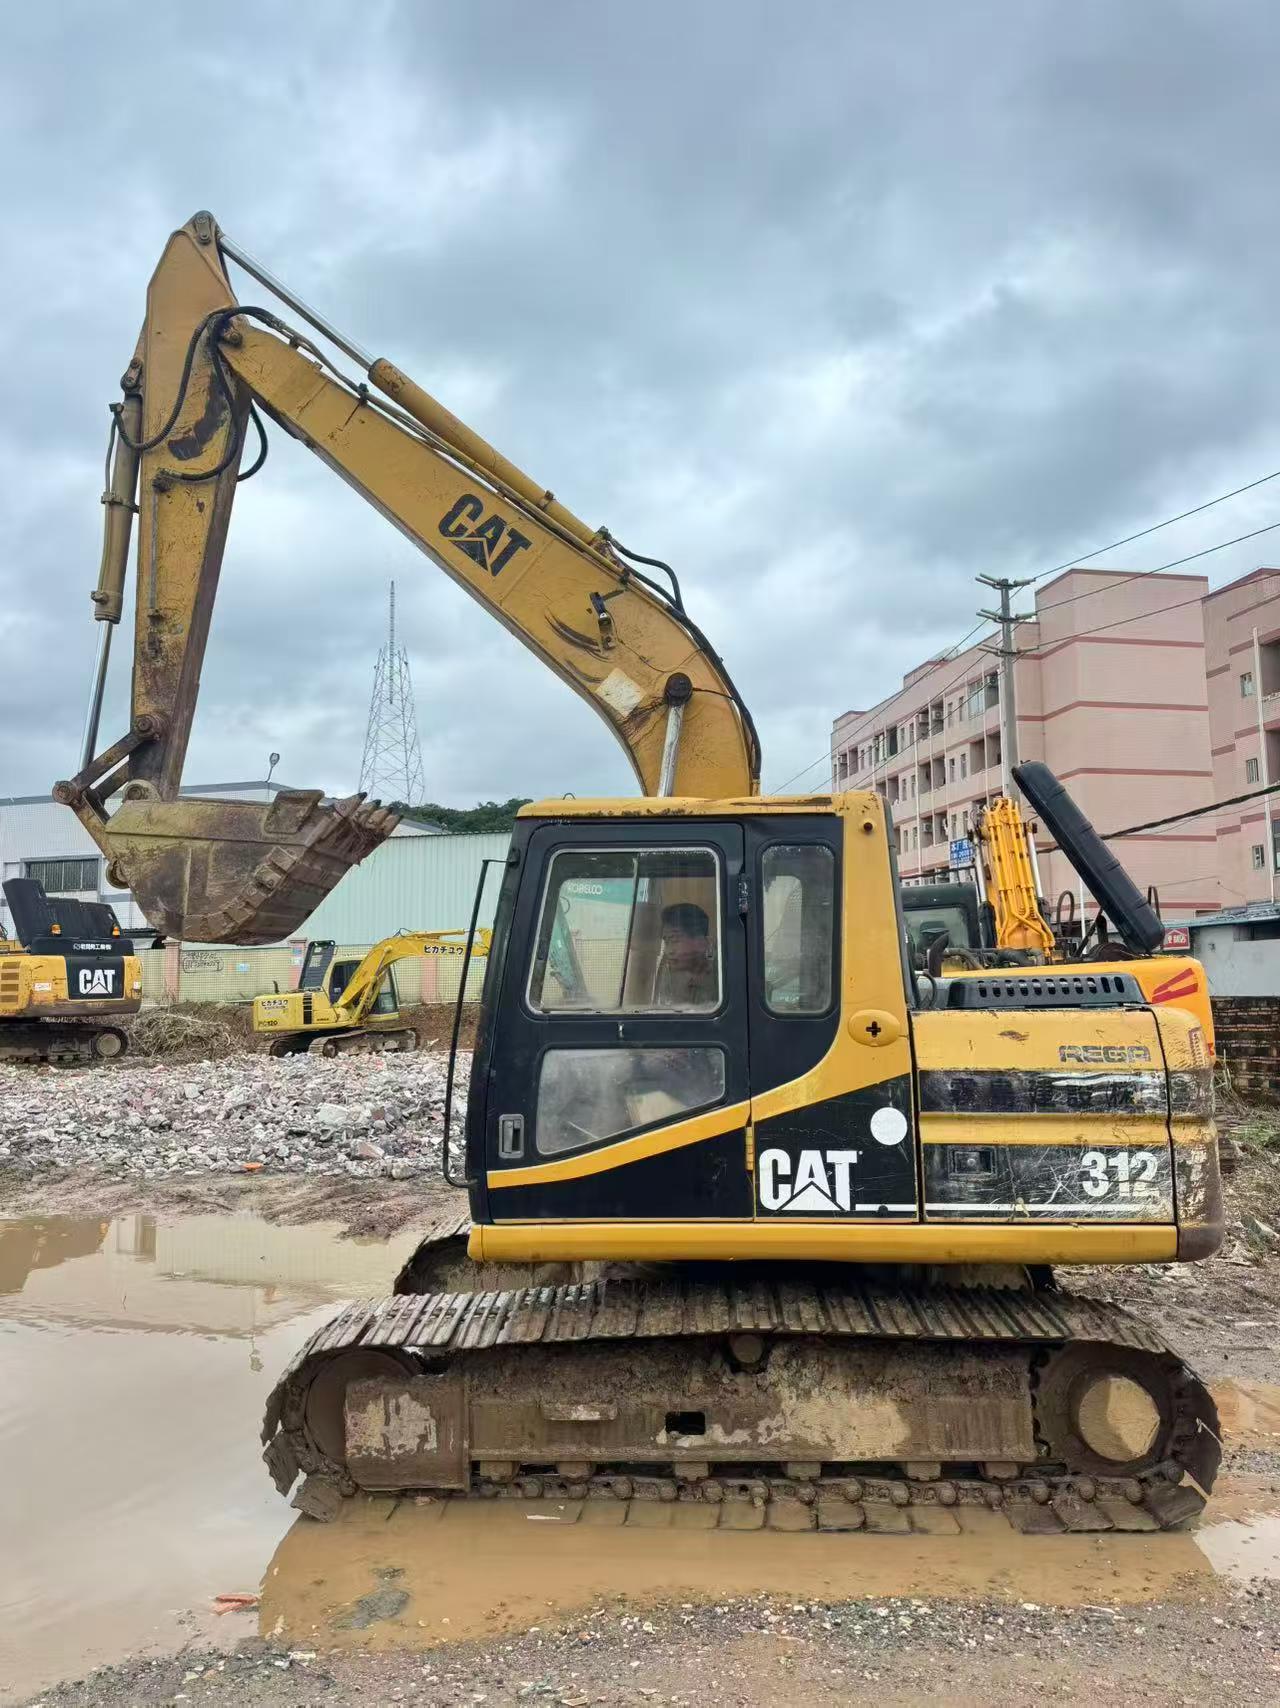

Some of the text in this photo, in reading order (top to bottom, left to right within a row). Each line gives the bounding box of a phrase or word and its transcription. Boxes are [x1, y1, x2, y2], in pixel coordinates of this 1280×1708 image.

[438, 493, 533, 577] CAT
[79, 969, 116, 995] CAT
[1059, 1045, 1151, 1063] REGA
[759, 1148, 858, 1211] CAT
[1081, 1151, 1160, 1197] 312
